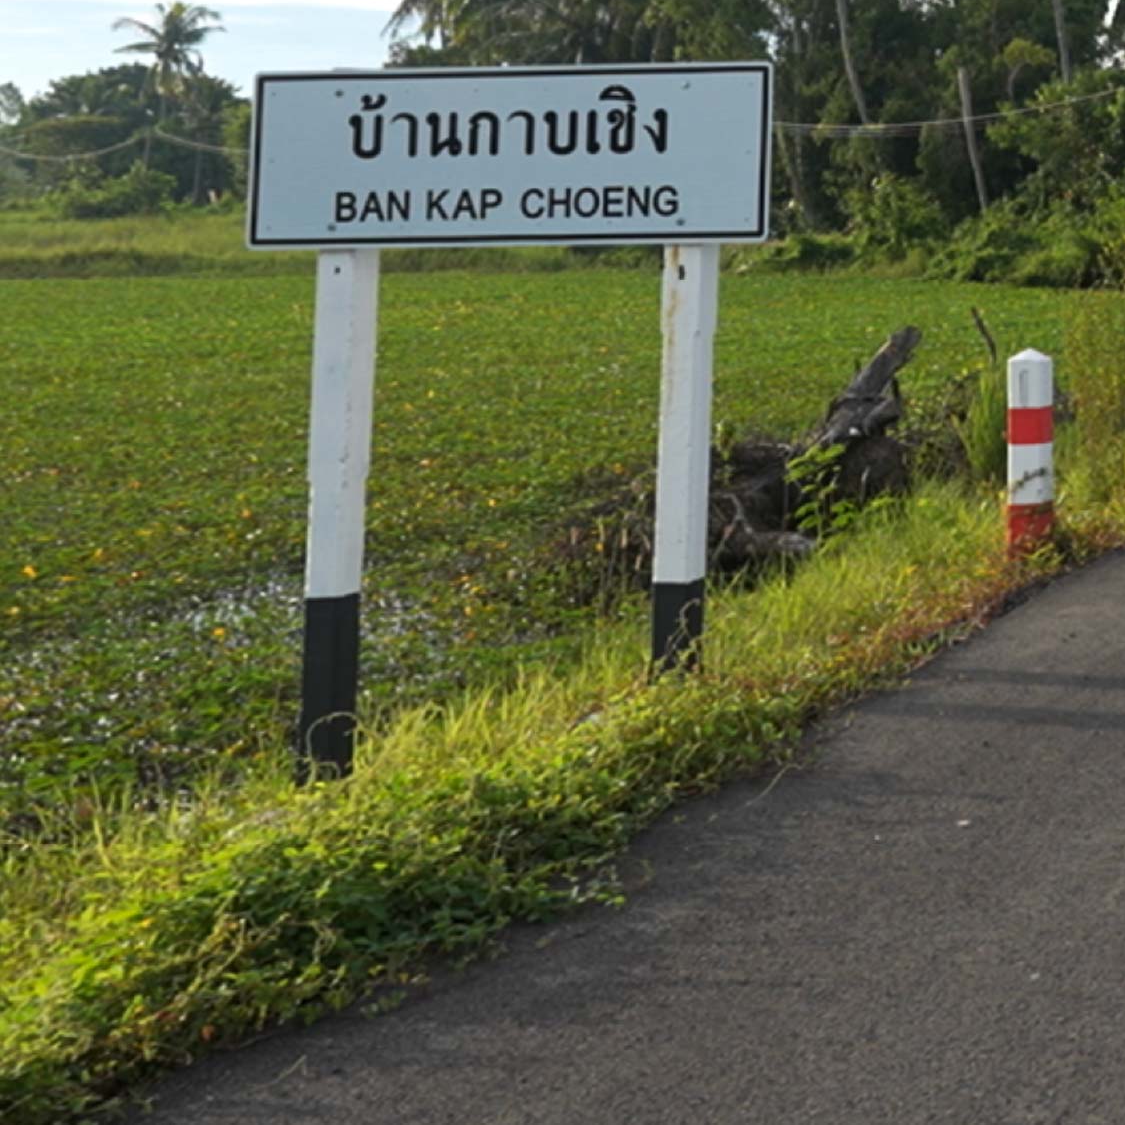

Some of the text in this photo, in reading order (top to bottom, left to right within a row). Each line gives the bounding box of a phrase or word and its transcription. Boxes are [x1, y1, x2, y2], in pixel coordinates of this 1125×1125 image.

[348, 85, 668, 159] บ้านกาบเชิง
[335, 185, 680, 222] BAN KAP CHOENG
